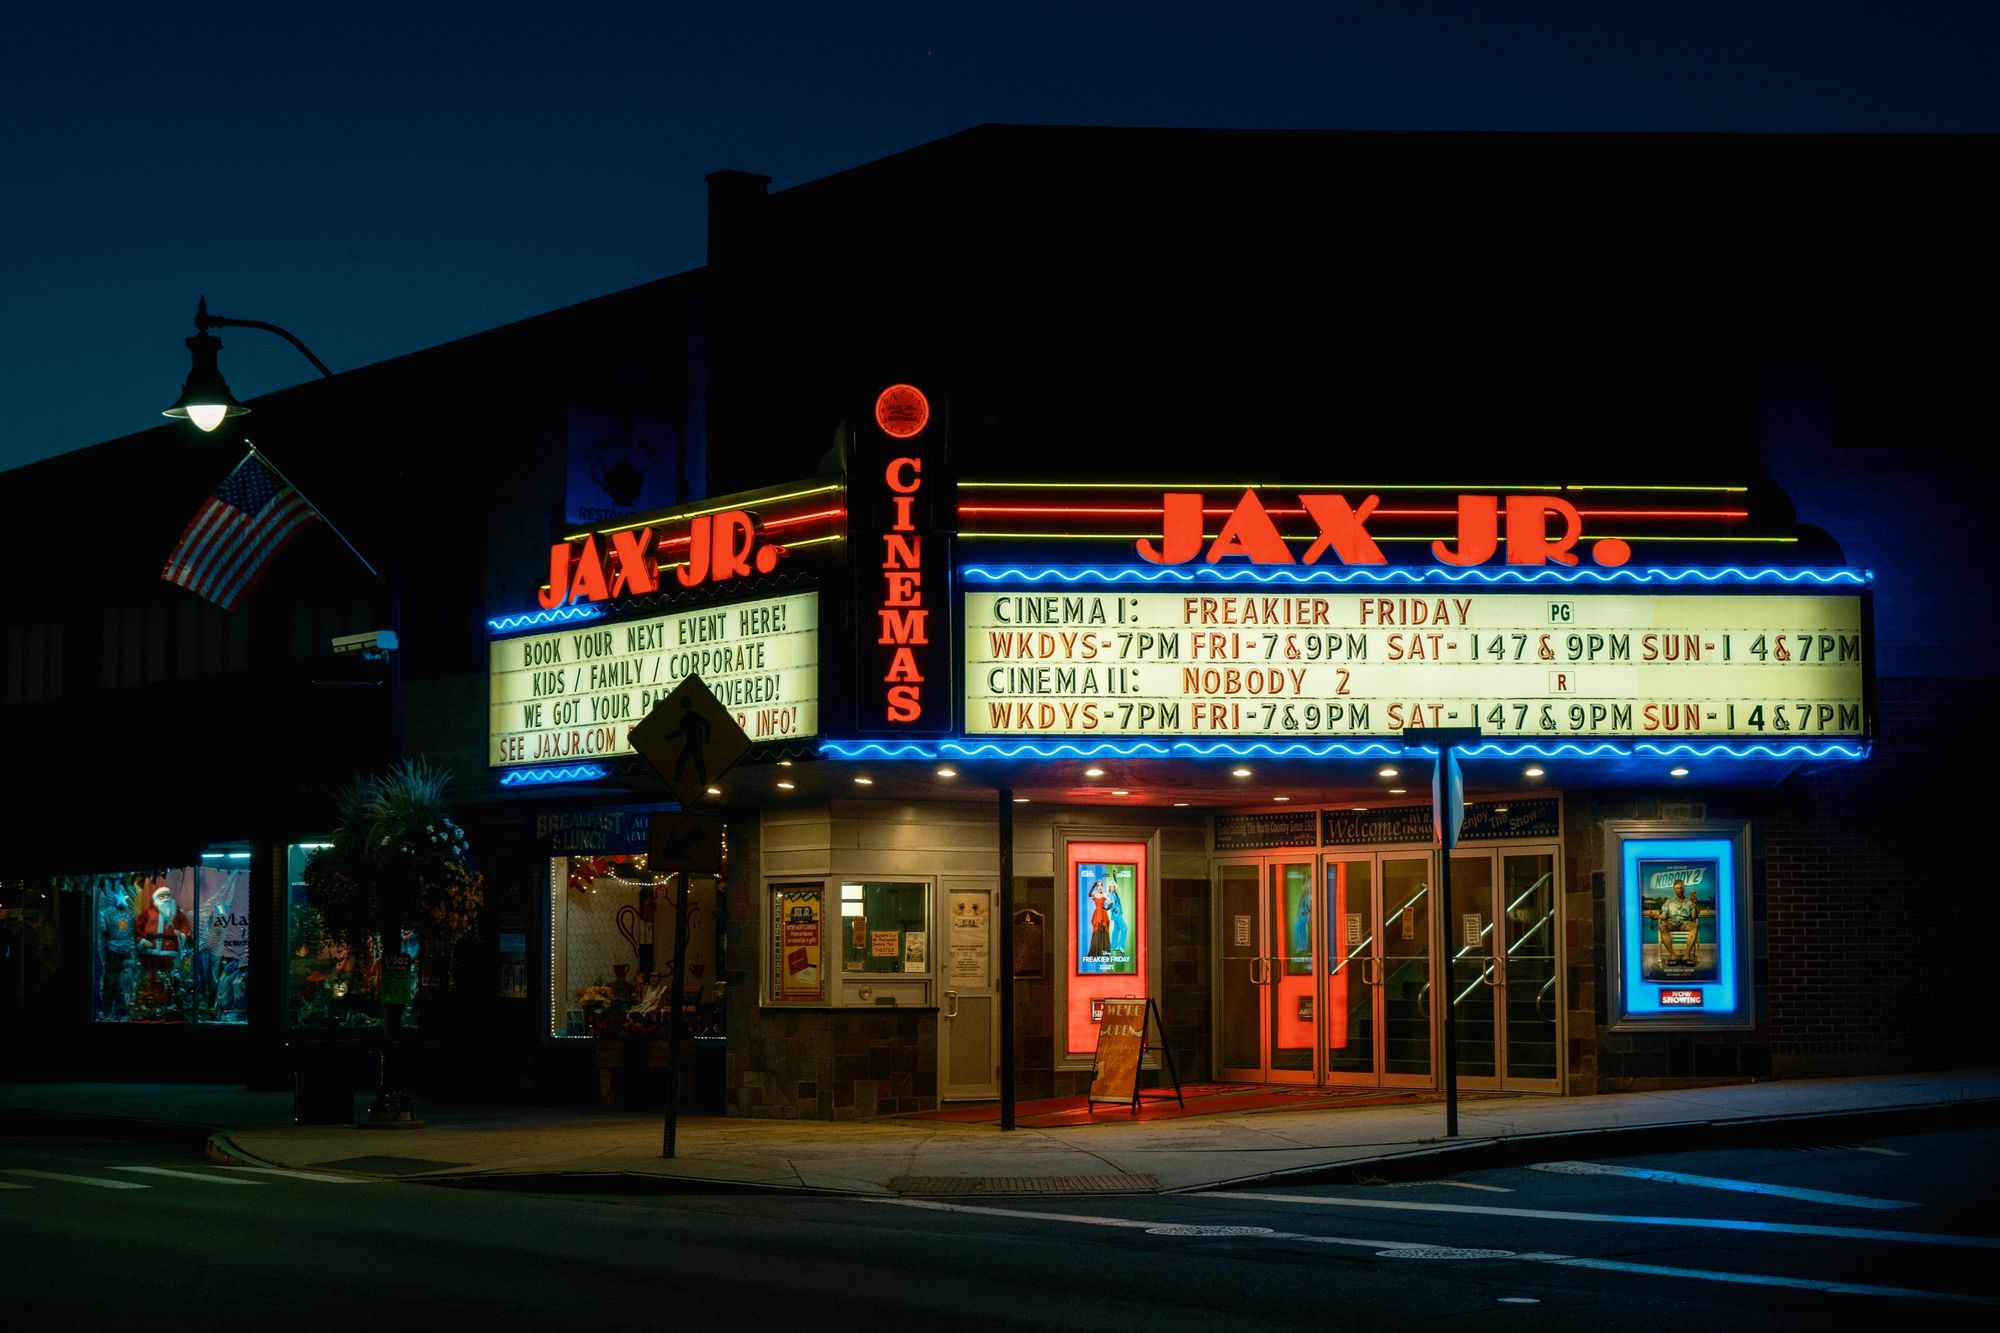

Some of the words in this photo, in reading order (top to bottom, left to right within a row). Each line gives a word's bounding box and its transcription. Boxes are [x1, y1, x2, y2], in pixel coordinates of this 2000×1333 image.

[1135, 487, 1390, 566] JAX
[1431, 493, 1633, 568] JR.
[537, 526, 654, 610] JAX
[676, 510, 779, 588] JR.
[877, 456, 930, 723] CINEMAS
[993, 596, 1107, 625] CINEMA
[1183, 597, 1331, 625] FREAKIER
[1360, 598, 1473, 626] FRIDAY
[1551, 603, 1571, 622] PG
[524, 641, 562, 667] BOOK
[574, 630, 614, 660] YOUR
[627, 621, 665, 652] NEXT
[679, 612, 727, 646] EVENT
[739, 603, 787, 637] HERE!
[989, 631, 1179, 660] WKDYS-7PM
[533, 670, 565, 697] KIDS
[590, 657, 644, 690] FAMILY
[670, 641, 766, 680] CORPORATE
[987, 666, 1099, 694] CINEMA
[1183, 667, 1307, 695] NOBODY
[1335, 668, 1351, 695] 2
[1557, 673, 1567, 692] R
[524, 702, 543, 729] WE
[552, 698, 580, 726] GOT
[592, 693, 631, 722] YOUR
[989, 701, 1181, 730] WKDYS-7PM
[499, 736, 525, 762] SEE
[533, 728, 617, 759] JAXJR.COM
[756, 706, 798, 737] INFO!
[536, 811, 625, 841] BREAKFAST
[1327, 815, 1401, 839] Welcome
[1462, 809, 1490, 830] Enjoy
[1488, 813, 1508, 830] The
[563, 831, 609, 851] LUNCH
[1655, 870, 1694, 888] NOBODY
[1693, 869, 1701, 883] 2
[1107, 1004, 1141, 1017] WE'RE
[1662, 996, 1701, 1004] SHOWING
[1107, 1023, 1139, 1037] OPEN
